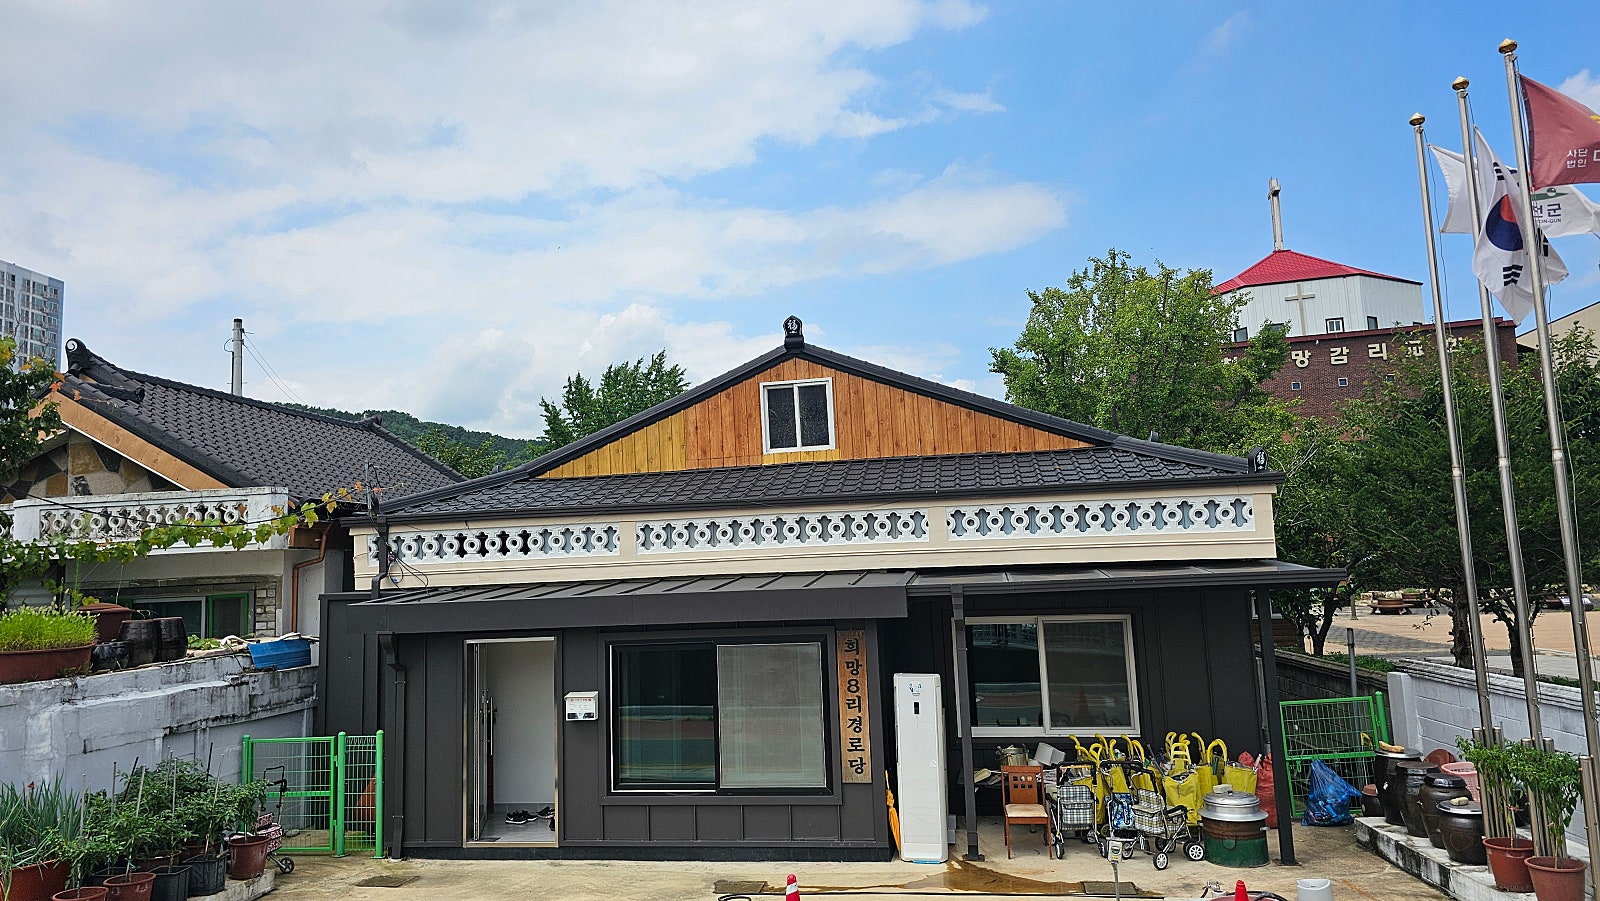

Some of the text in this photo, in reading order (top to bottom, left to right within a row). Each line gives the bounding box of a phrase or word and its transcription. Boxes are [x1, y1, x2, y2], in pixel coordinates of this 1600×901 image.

[1566, 148, 1588, 158] 사단
[1566, 159, 1587, 169] 법인
[1533, 203, 1562, 218] 천군
